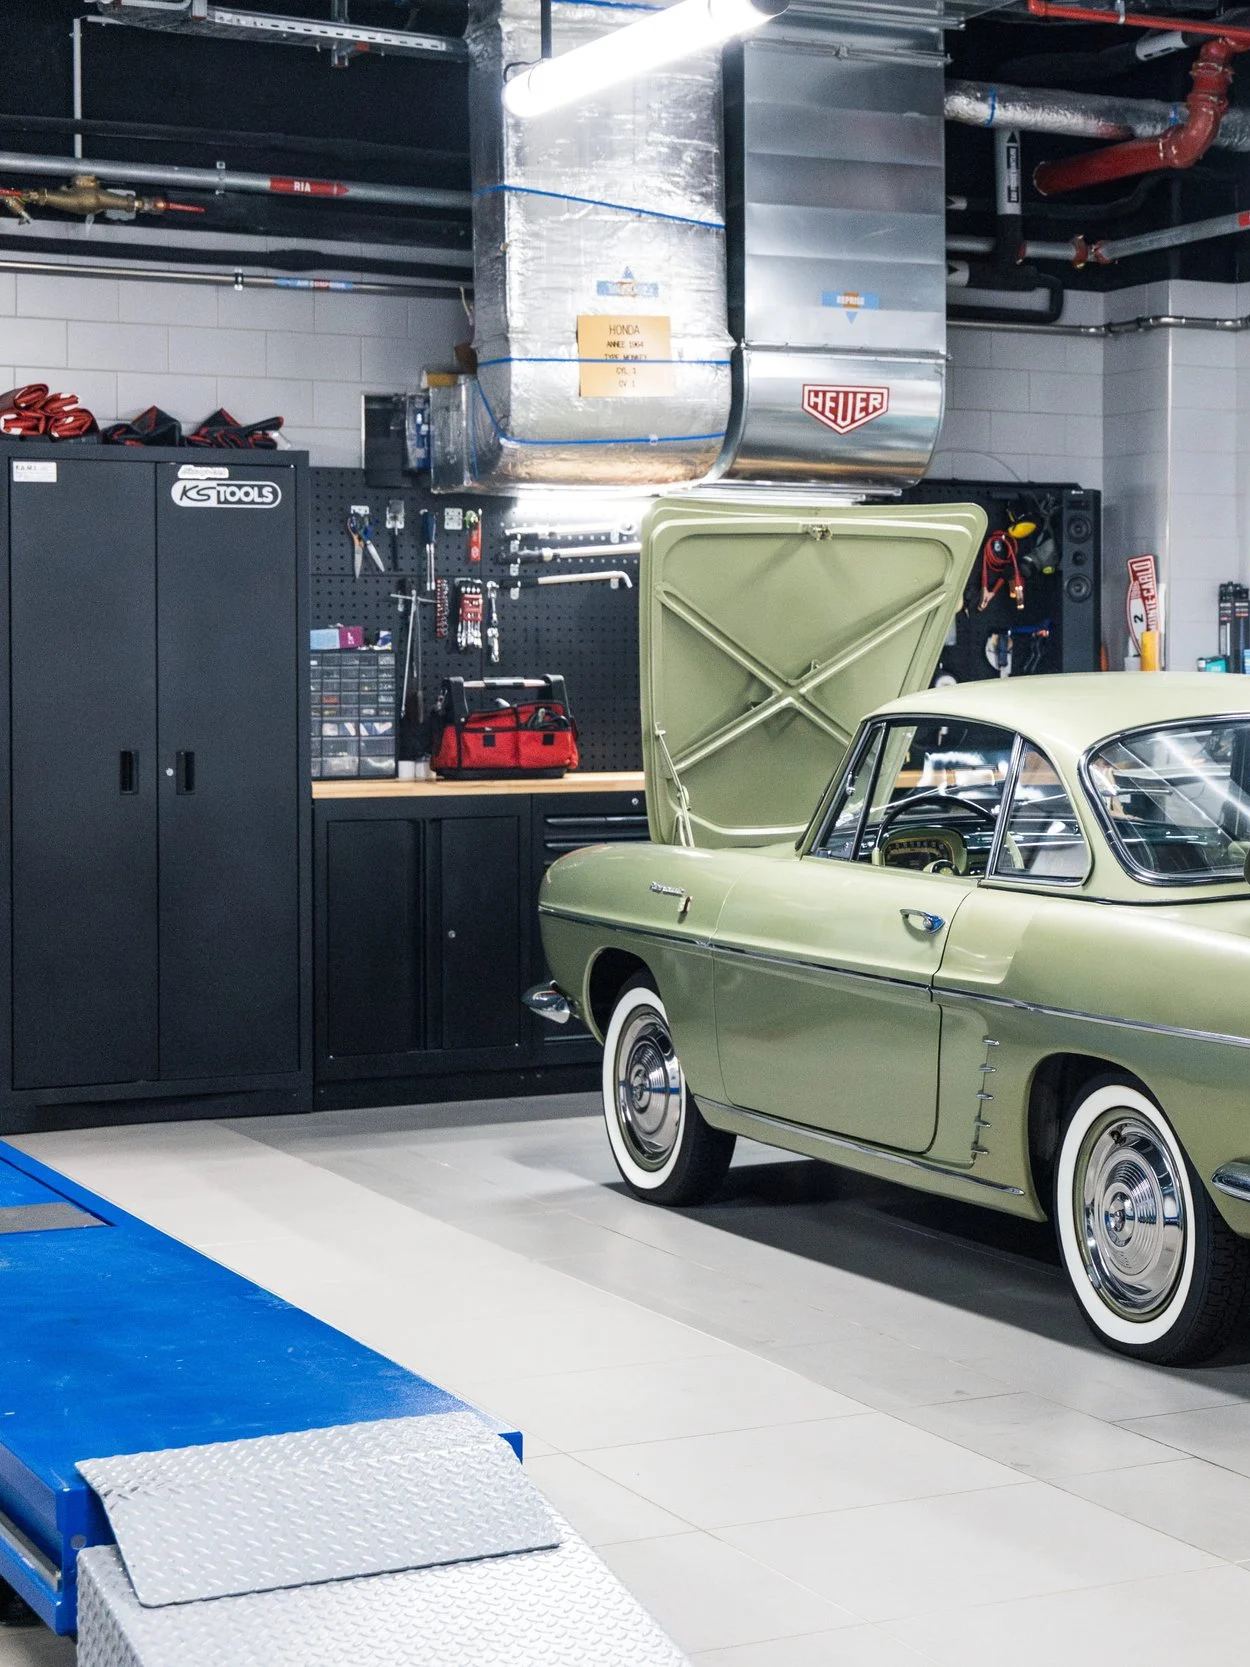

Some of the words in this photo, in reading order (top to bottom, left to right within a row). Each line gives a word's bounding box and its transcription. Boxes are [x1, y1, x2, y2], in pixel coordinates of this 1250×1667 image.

[293, 181, 311, 192] RIA
[609, 324, 640, 335] HONDA
[809, 390, 882, 428] HEUER
[216, 486, 274, 503] TOOLS
[1134, 613, 1144, 624] 2
